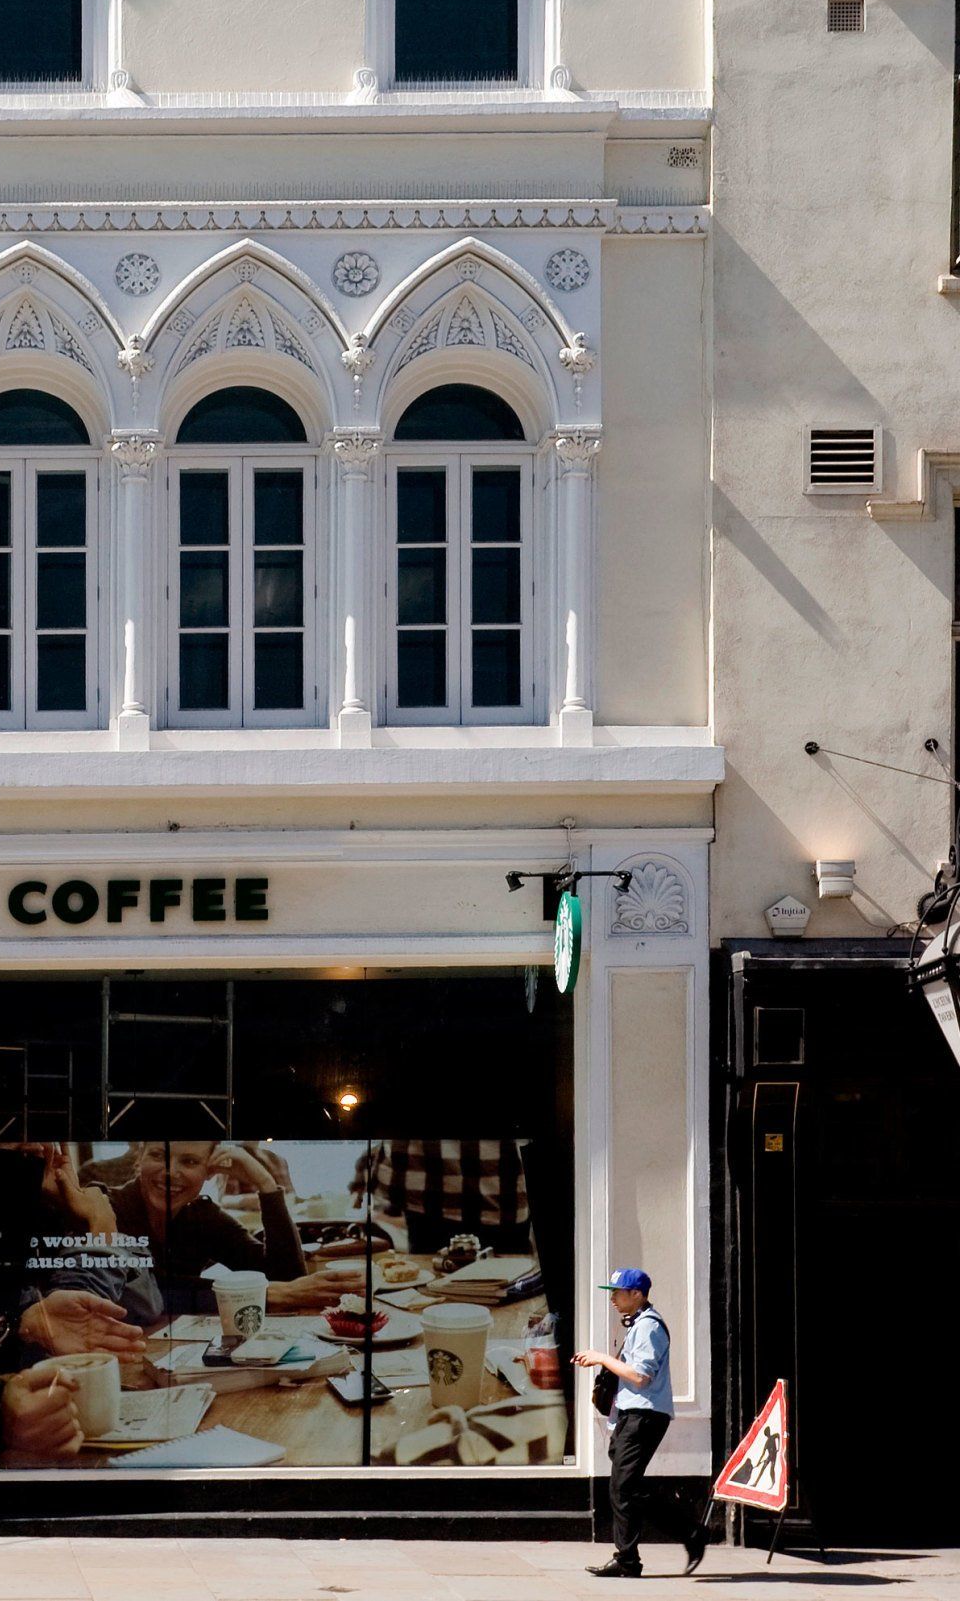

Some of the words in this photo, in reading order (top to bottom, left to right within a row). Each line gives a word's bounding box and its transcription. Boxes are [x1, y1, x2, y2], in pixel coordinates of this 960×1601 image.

[7, 878, 270, 924] COFFEE
[43, 1232, 107, 1247] world
[110, 1232, 150, 1247] has
[80, 1253, 154, 1268] button
